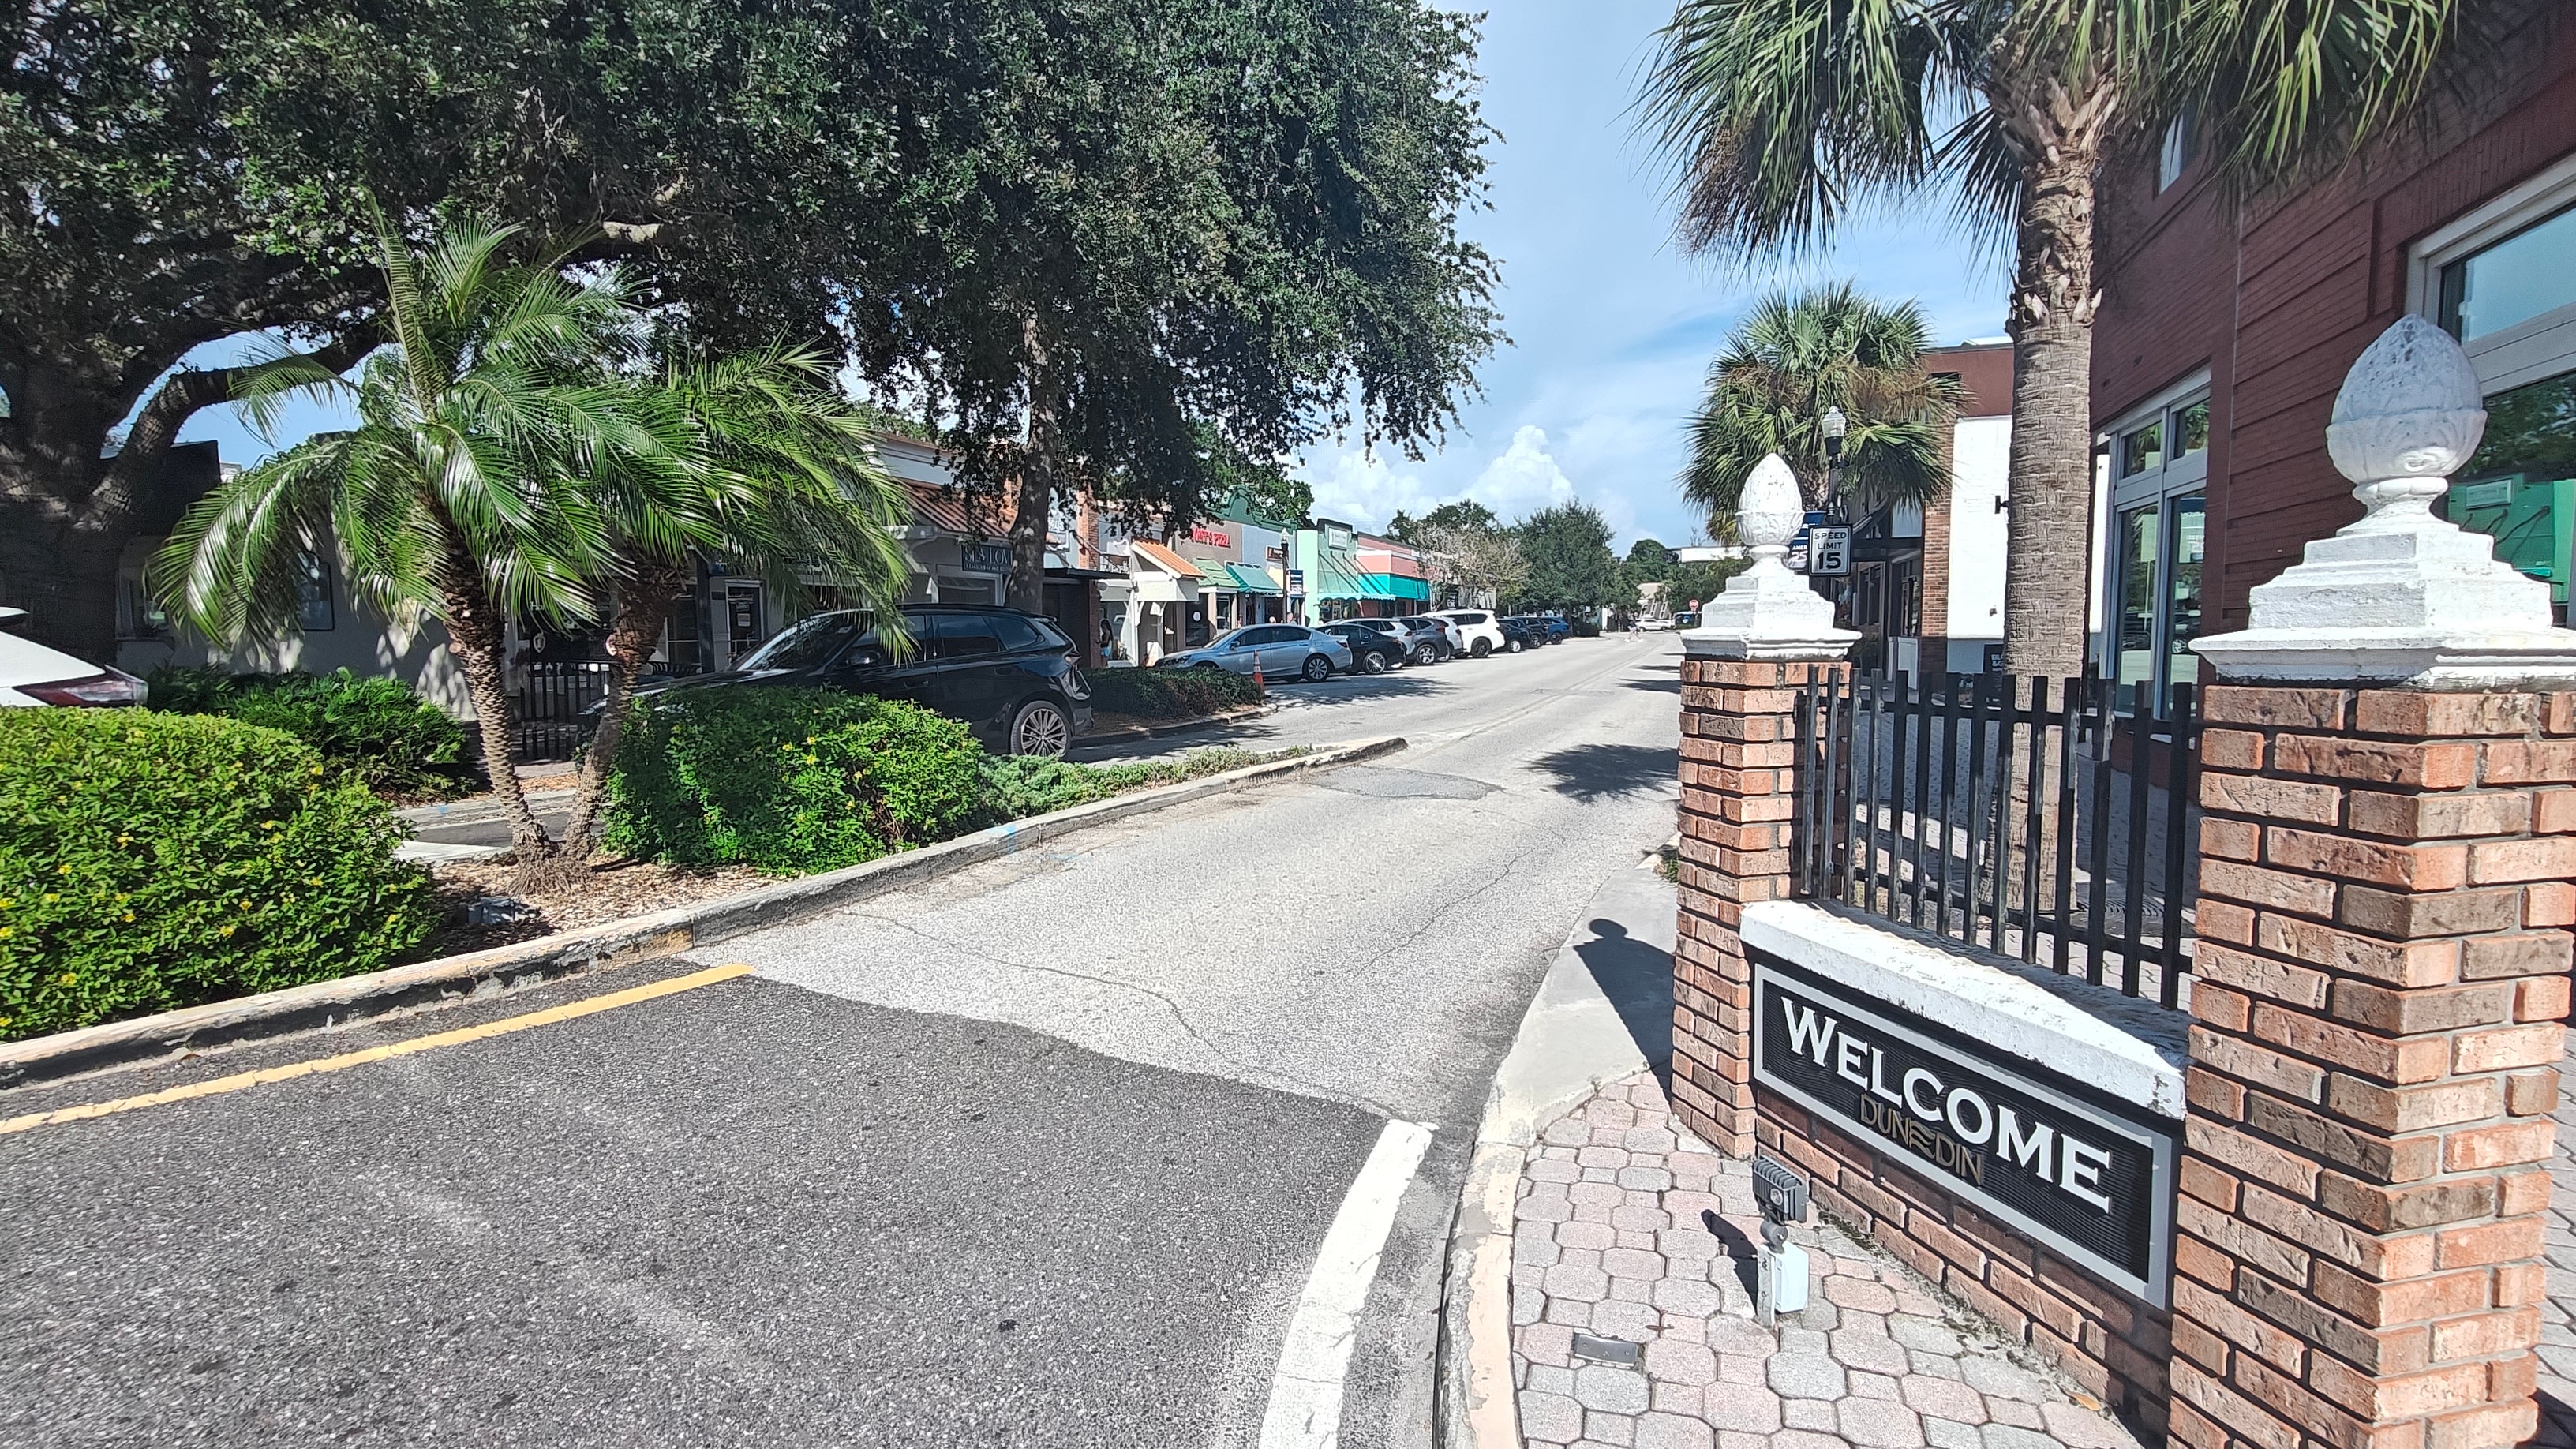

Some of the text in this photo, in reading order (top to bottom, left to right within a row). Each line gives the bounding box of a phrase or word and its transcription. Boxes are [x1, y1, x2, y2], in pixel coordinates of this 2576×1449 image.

[1814, 531, 1847, 540] SPEED
[1818, 541, 1843, 550] LIMIT
[1818, 552, 1842, 570] 15
[1780, 996, 2113, 1214] WELCOME
[1860, 1093, 1983, 1185] DUNEDIN
